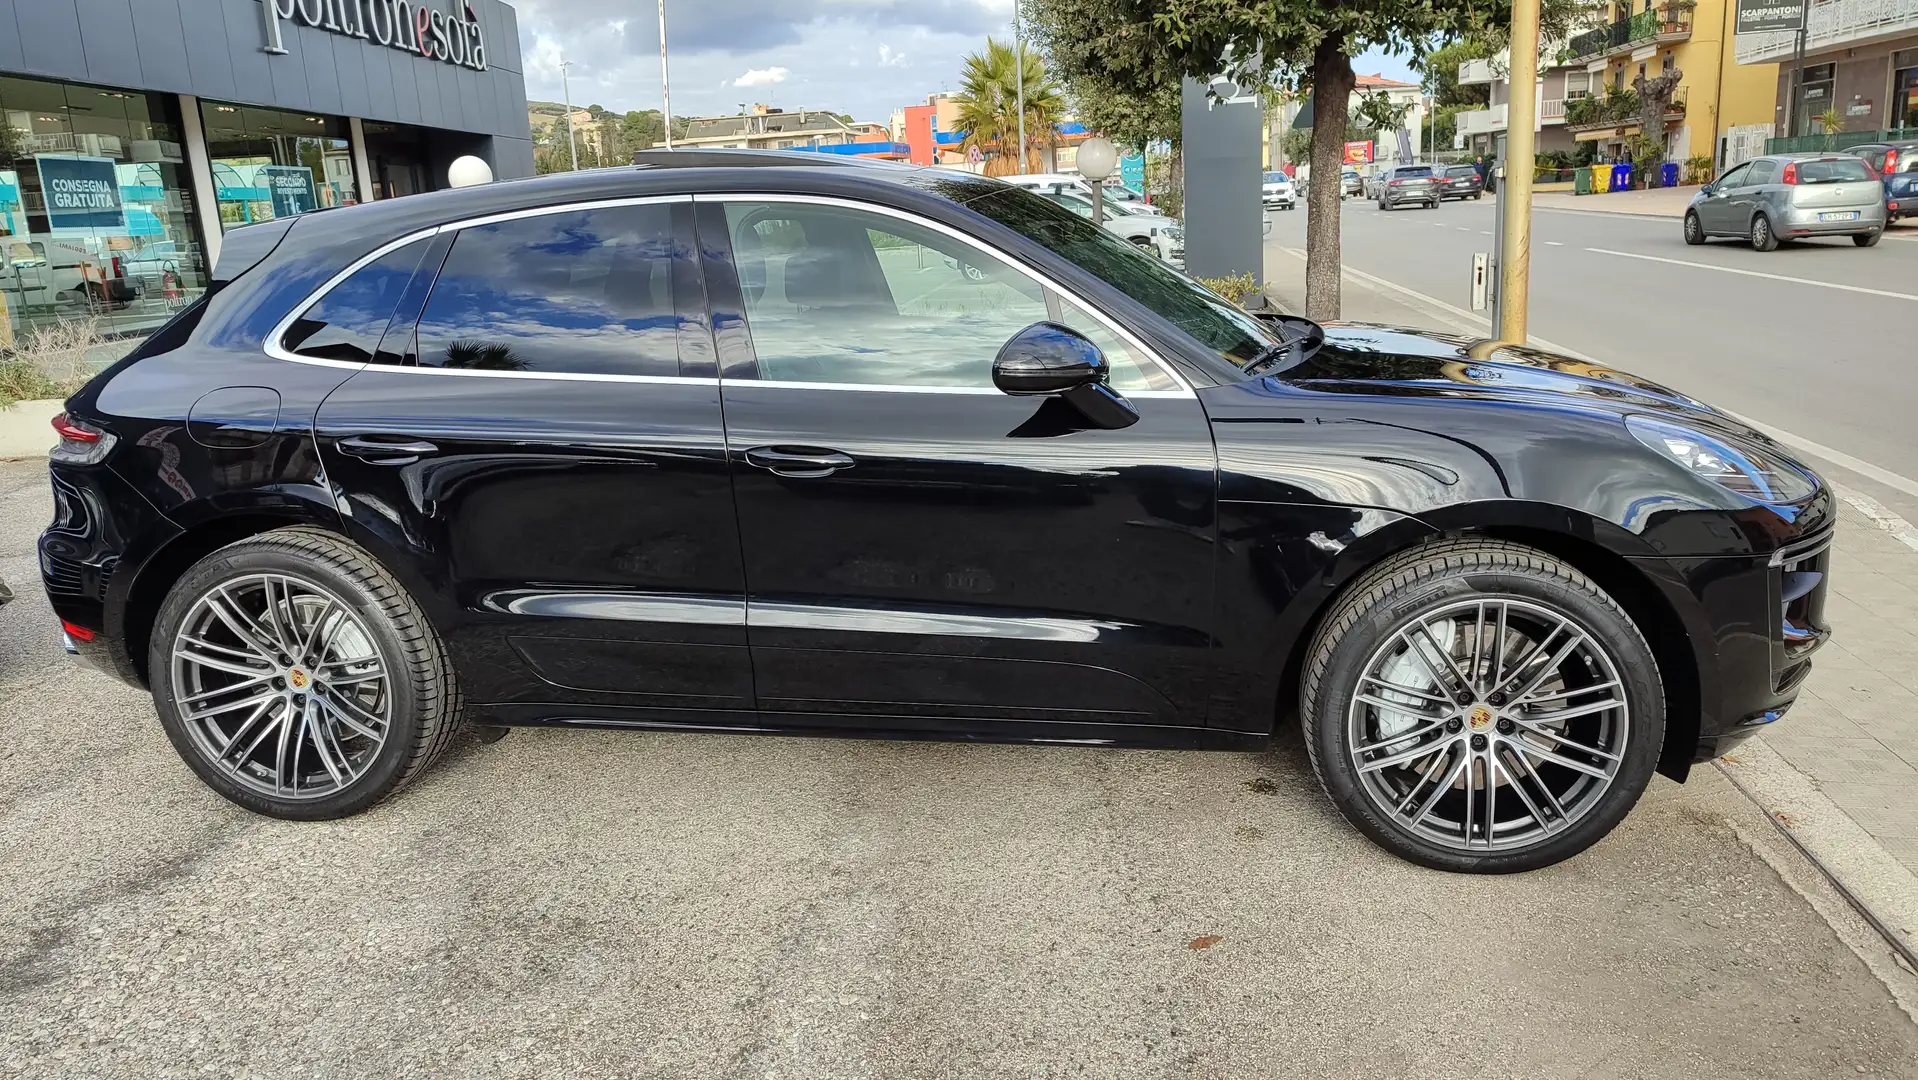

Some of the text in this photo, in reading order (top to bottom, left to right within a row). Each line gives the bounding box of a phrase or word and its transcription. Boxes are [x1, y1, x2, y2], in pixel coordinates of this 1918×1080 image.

[1741, 5, 1801, 17] SCARPANTONI
[52, 179, 111, 193] CONSEGNA
[55, 193, 115, 208] GRATUITA
